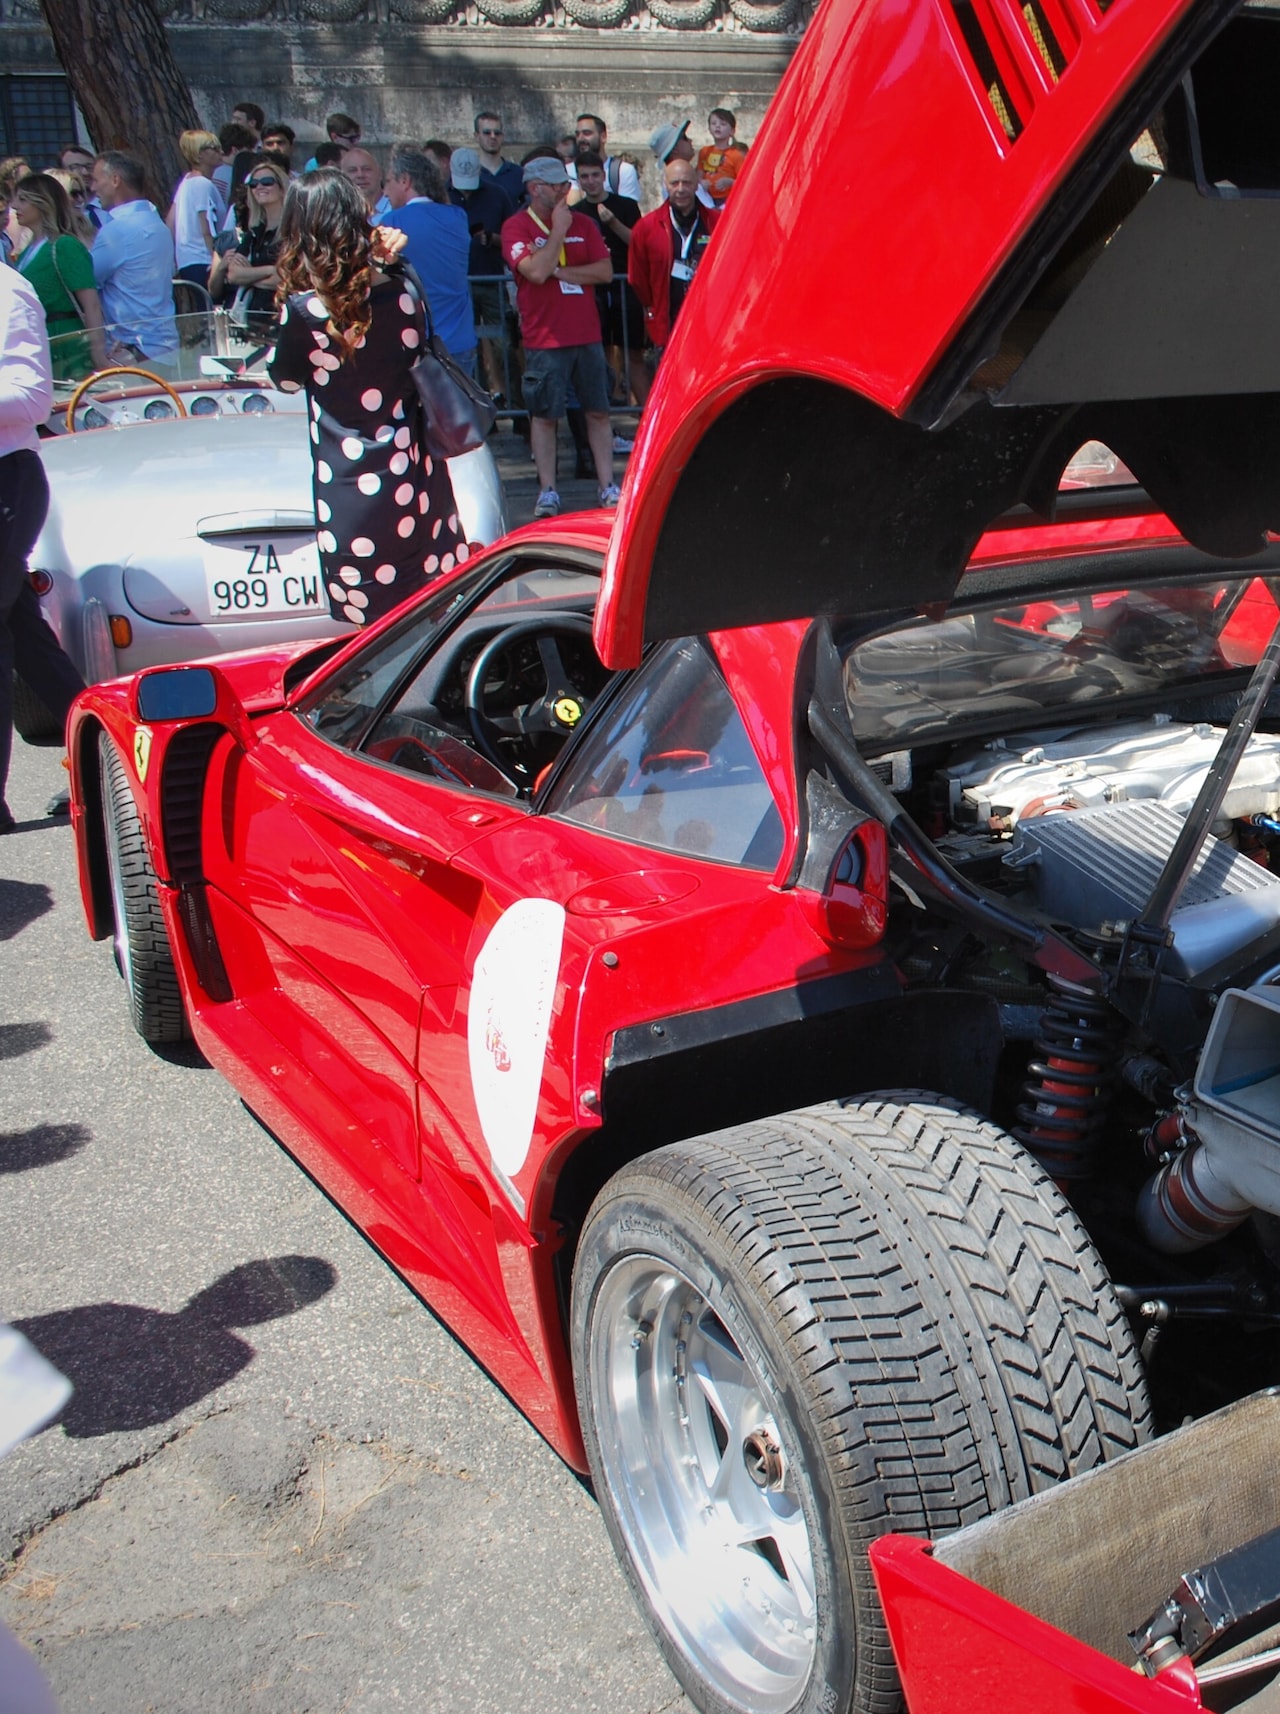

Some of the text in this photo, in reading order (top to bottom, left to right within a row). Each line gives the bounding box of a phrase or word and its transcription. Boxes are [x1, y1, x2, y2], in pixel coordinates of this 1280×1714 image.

[244, 544, 281, 574] ZA
[214, 576, 318, 610] 989 CW
